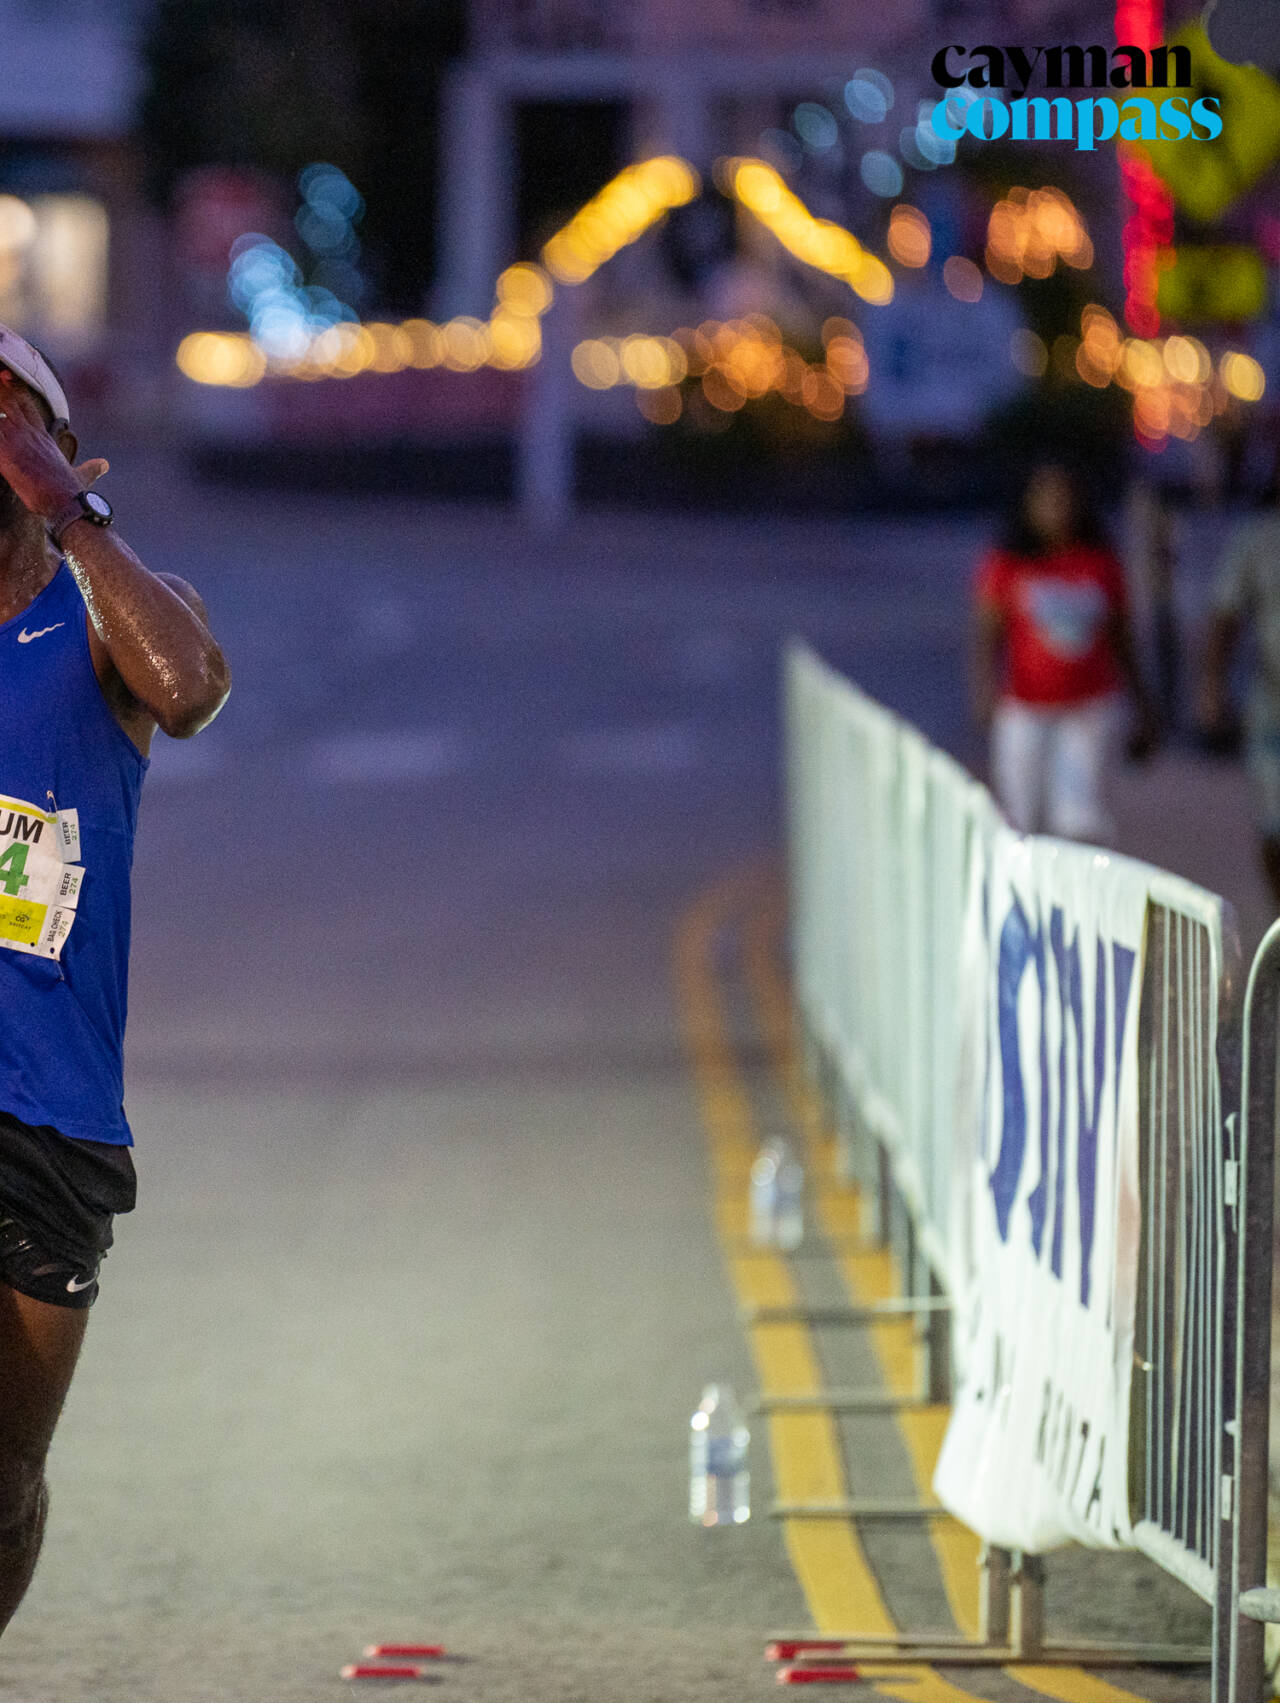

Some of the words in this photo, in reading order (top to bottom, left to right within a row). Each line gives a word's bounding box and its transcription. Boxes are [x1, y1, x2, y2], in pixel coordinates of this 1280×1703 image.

[61, 821, 72, 846] BEER
[59, 872, 72, 897] BEER
[69, 876, 79, 895] 274
[51, 909, 64, 930] CHECK
[58, 919, 69, 938] 274
